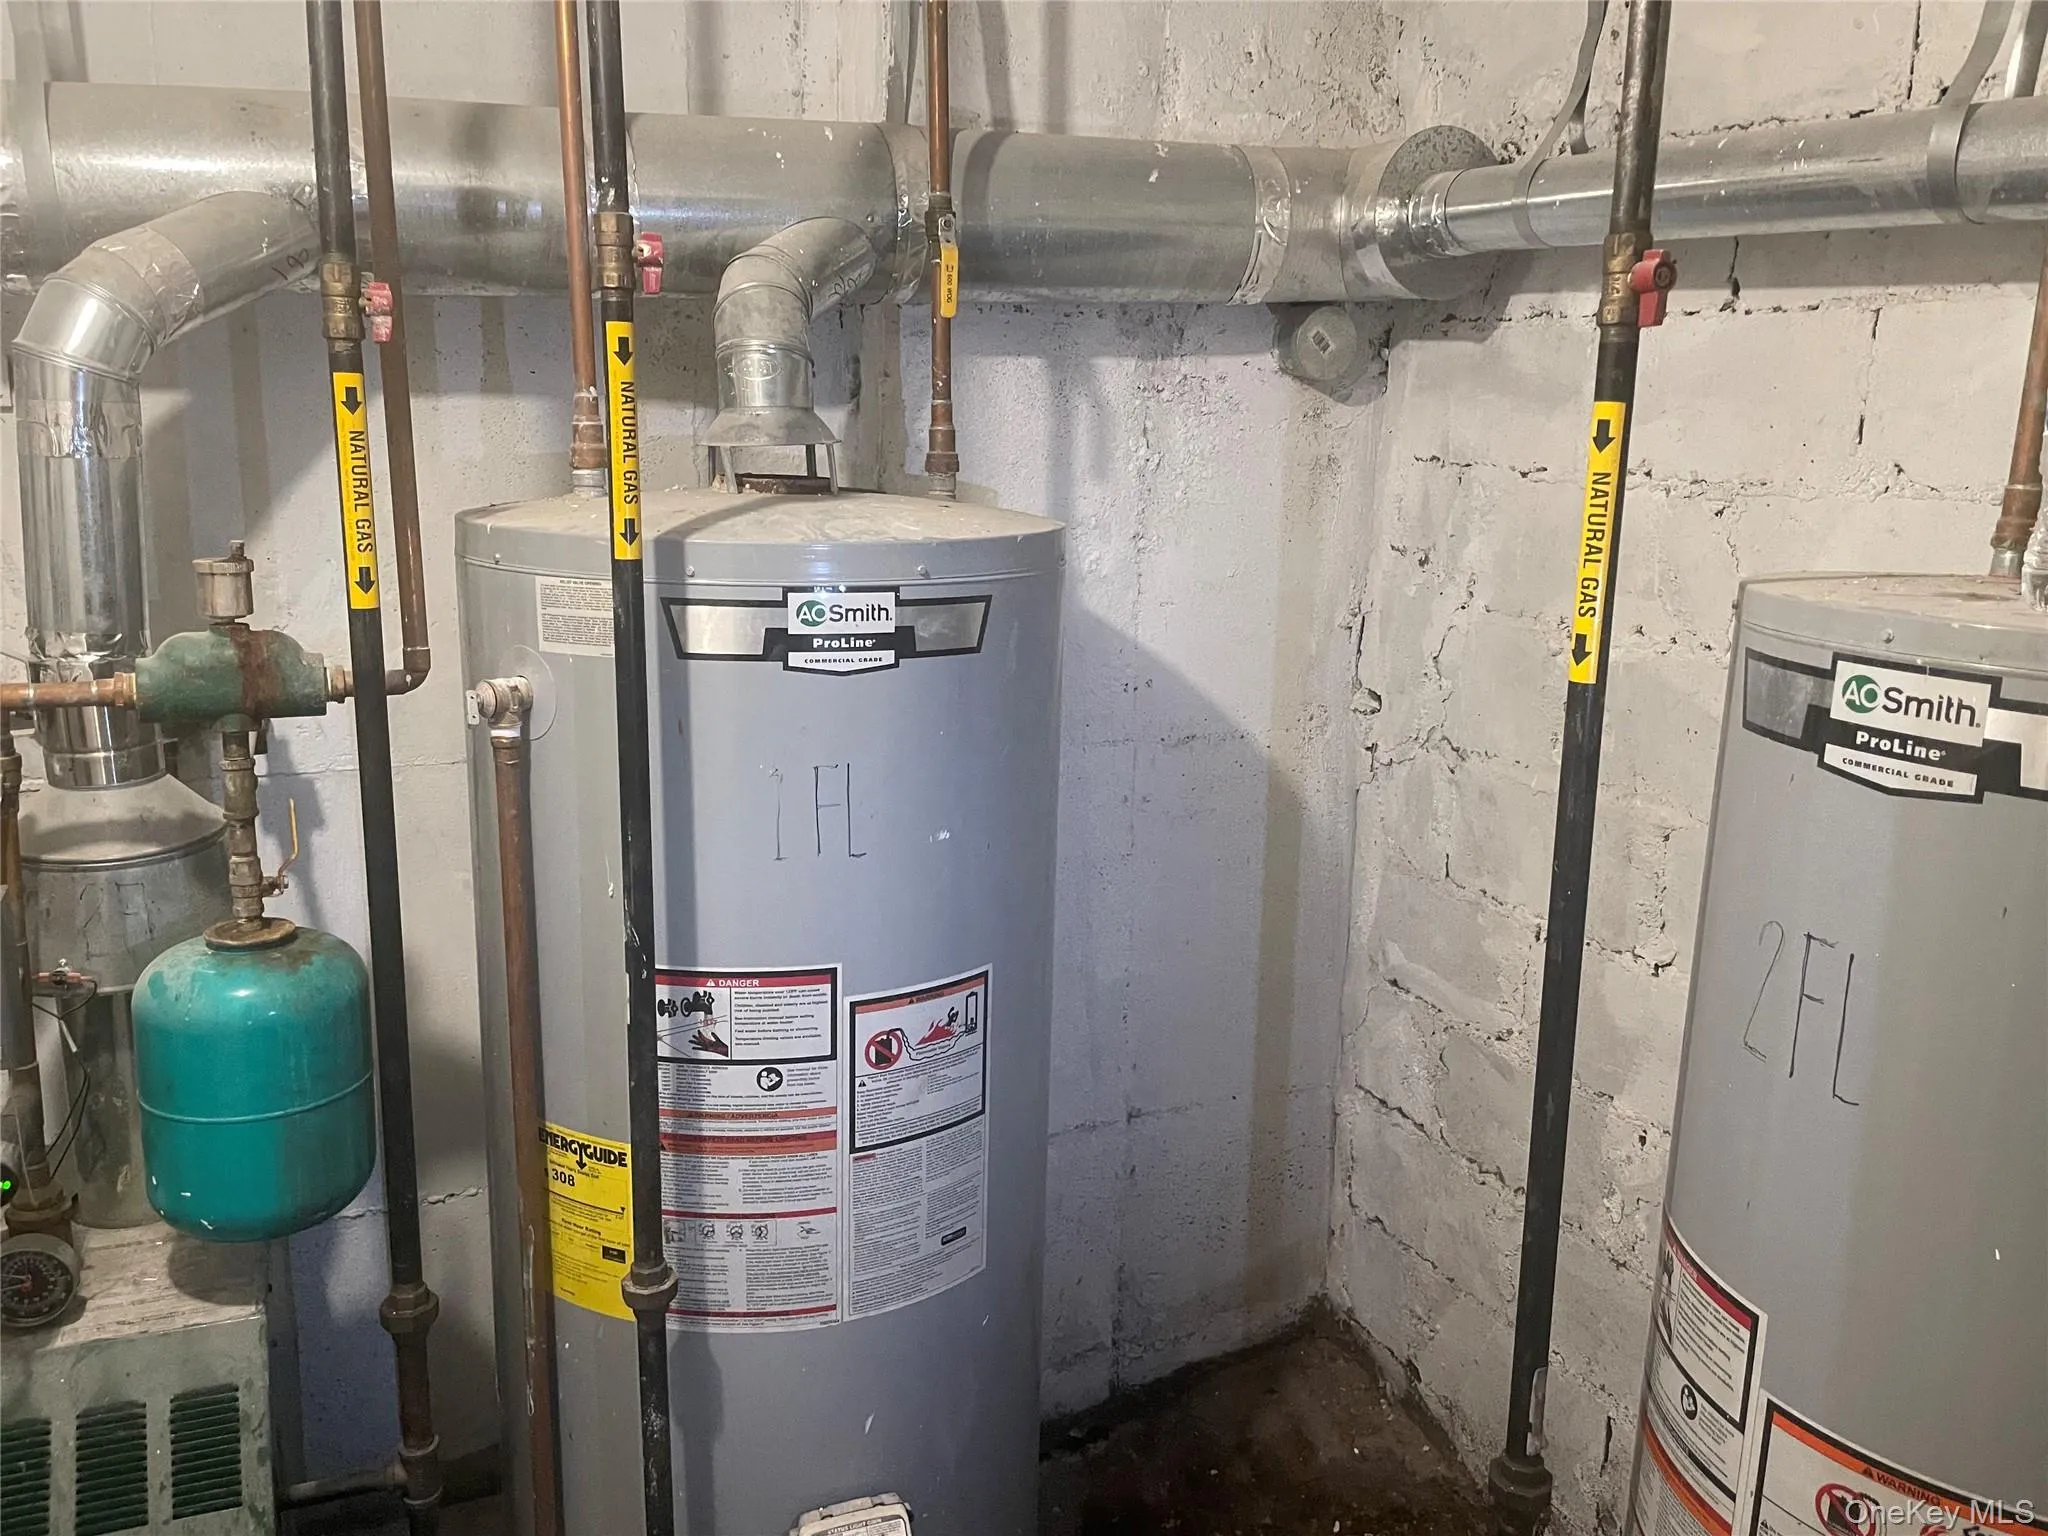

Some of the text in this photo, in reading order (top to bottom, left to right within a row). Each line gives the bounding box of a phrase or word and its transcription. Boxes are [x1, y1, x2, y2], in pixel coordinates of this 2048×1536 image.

[620, 381, 639, 505] NATURAL GAS
[348, 430, 371, 513] NATURAL
[355, 518, 373, 554] GAS
[1577, 471, 1612, 619] NATURAL GAS
[812, 637, 873, 649] ProLine
[1855, 731, 1941, 761] ProLine
[1841, 757, 1955, 788] COMMERCIAL GRADE
[718, 979, 760, 987] DANGER
[551, 1168, 576, 1187] 308
[1875, 1471, 1941, 1507] WARNING
